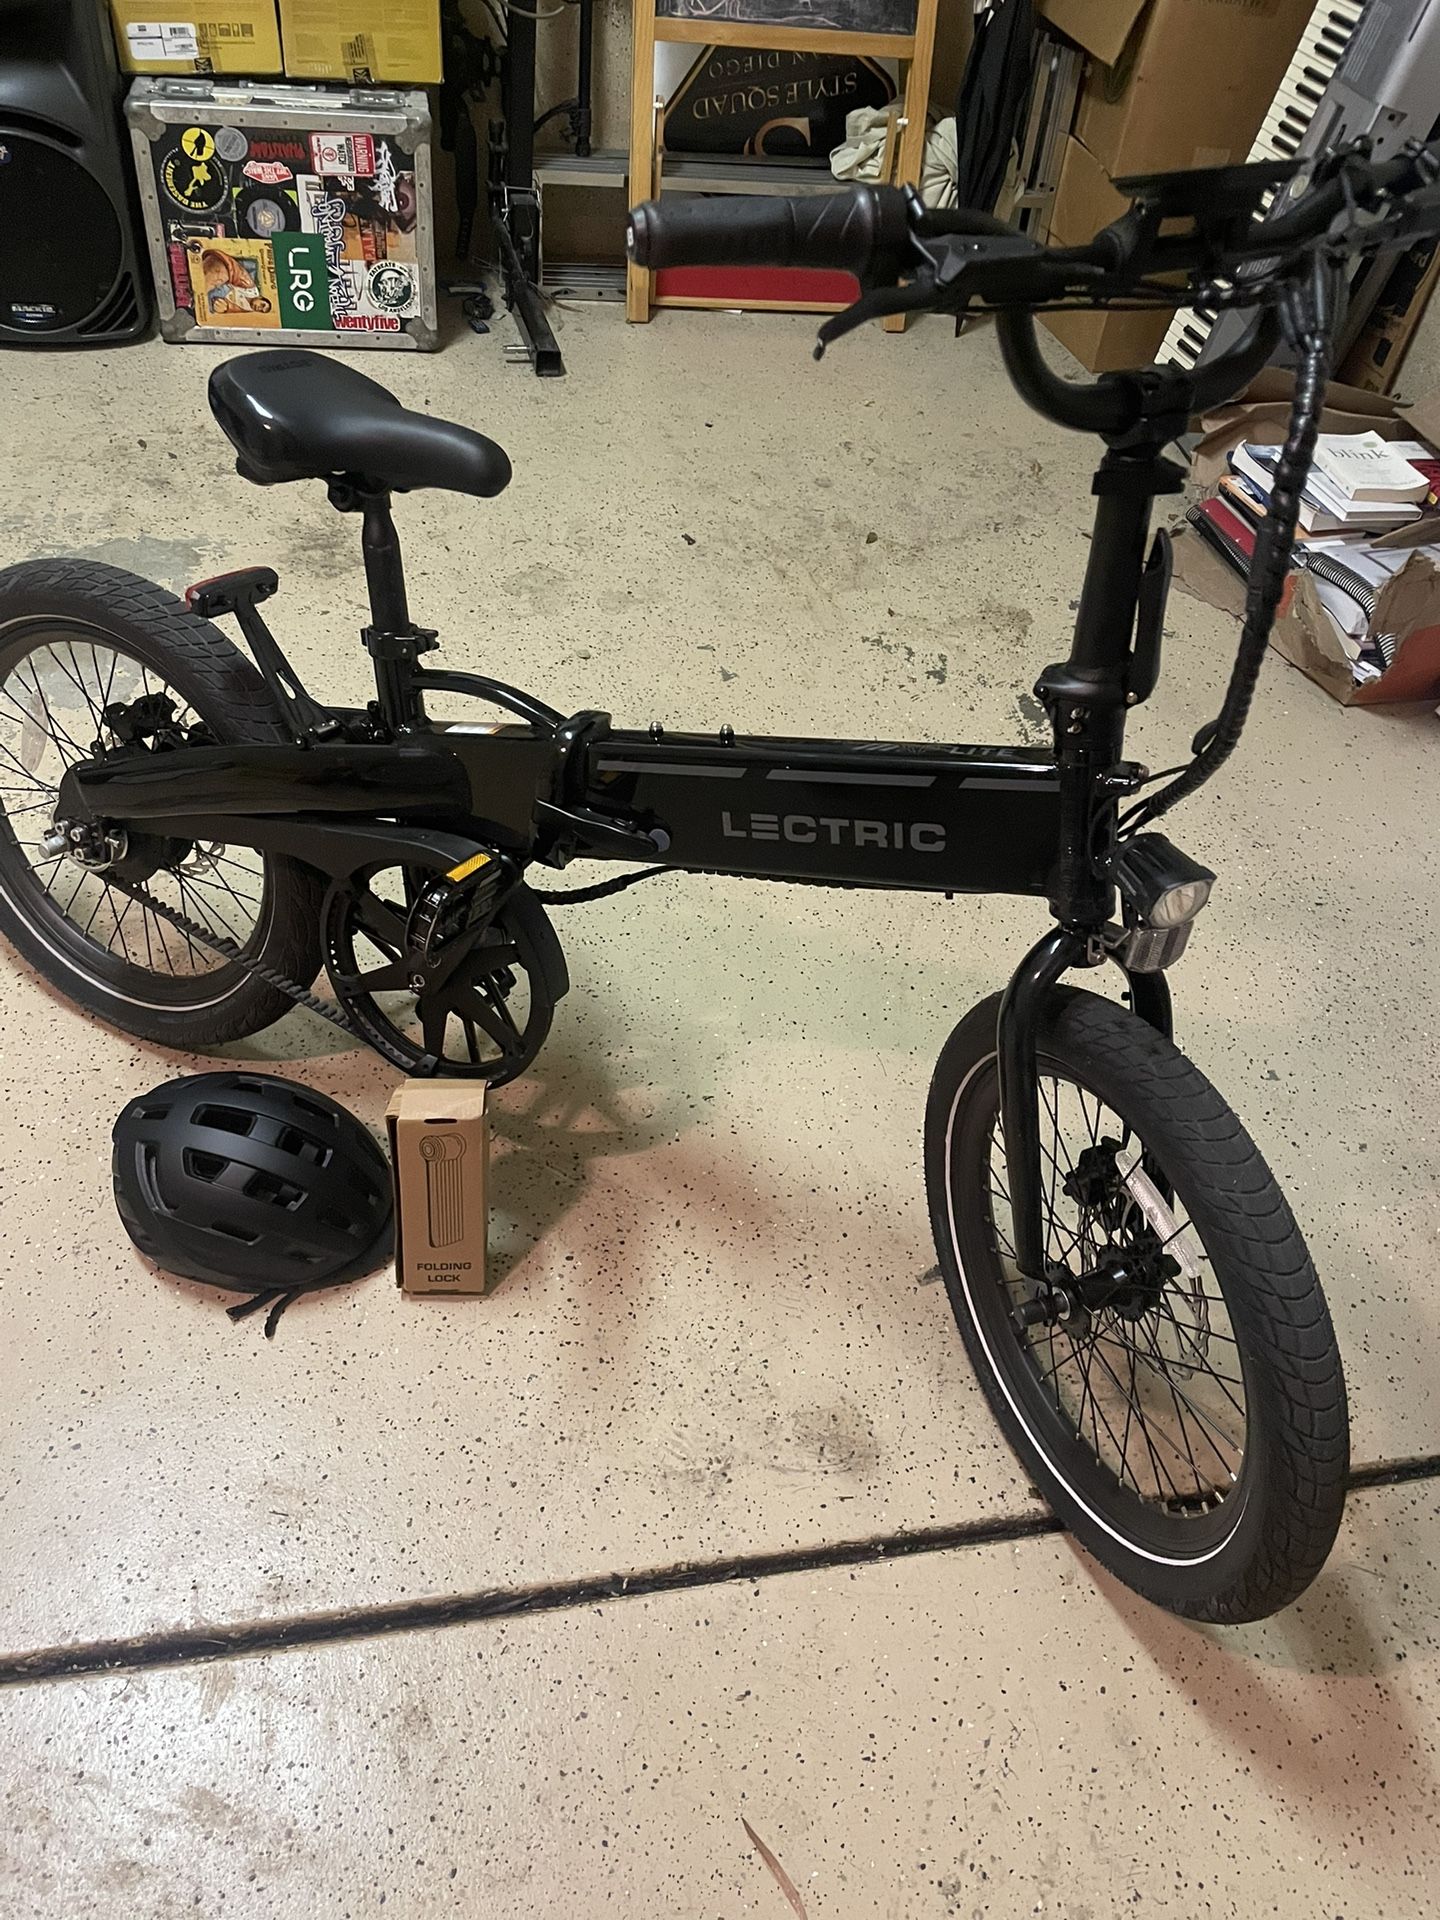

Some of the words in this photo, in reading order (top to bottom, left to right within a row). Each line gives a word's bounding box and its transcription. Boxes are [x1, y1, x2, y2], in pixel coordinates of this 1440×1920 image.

[708, 53, 780, 78] DIEGO
[785, 72, 858, 105] STYLE
[692, 85, 780, 120] SQUAD
[336, 144, 346, 166] WATCH
[356, 136, 371, 174] WARNING
[288, 247, 315, 312] LRG
[1327, 447, 1389, 460] blink
[949, 747, 1016, 757] LITE
[721, 811, 946, 852] LECTRIC
[417, 1262, 473, 1271] FOLDING
[428, 1274, 462, 1283] LOCK
